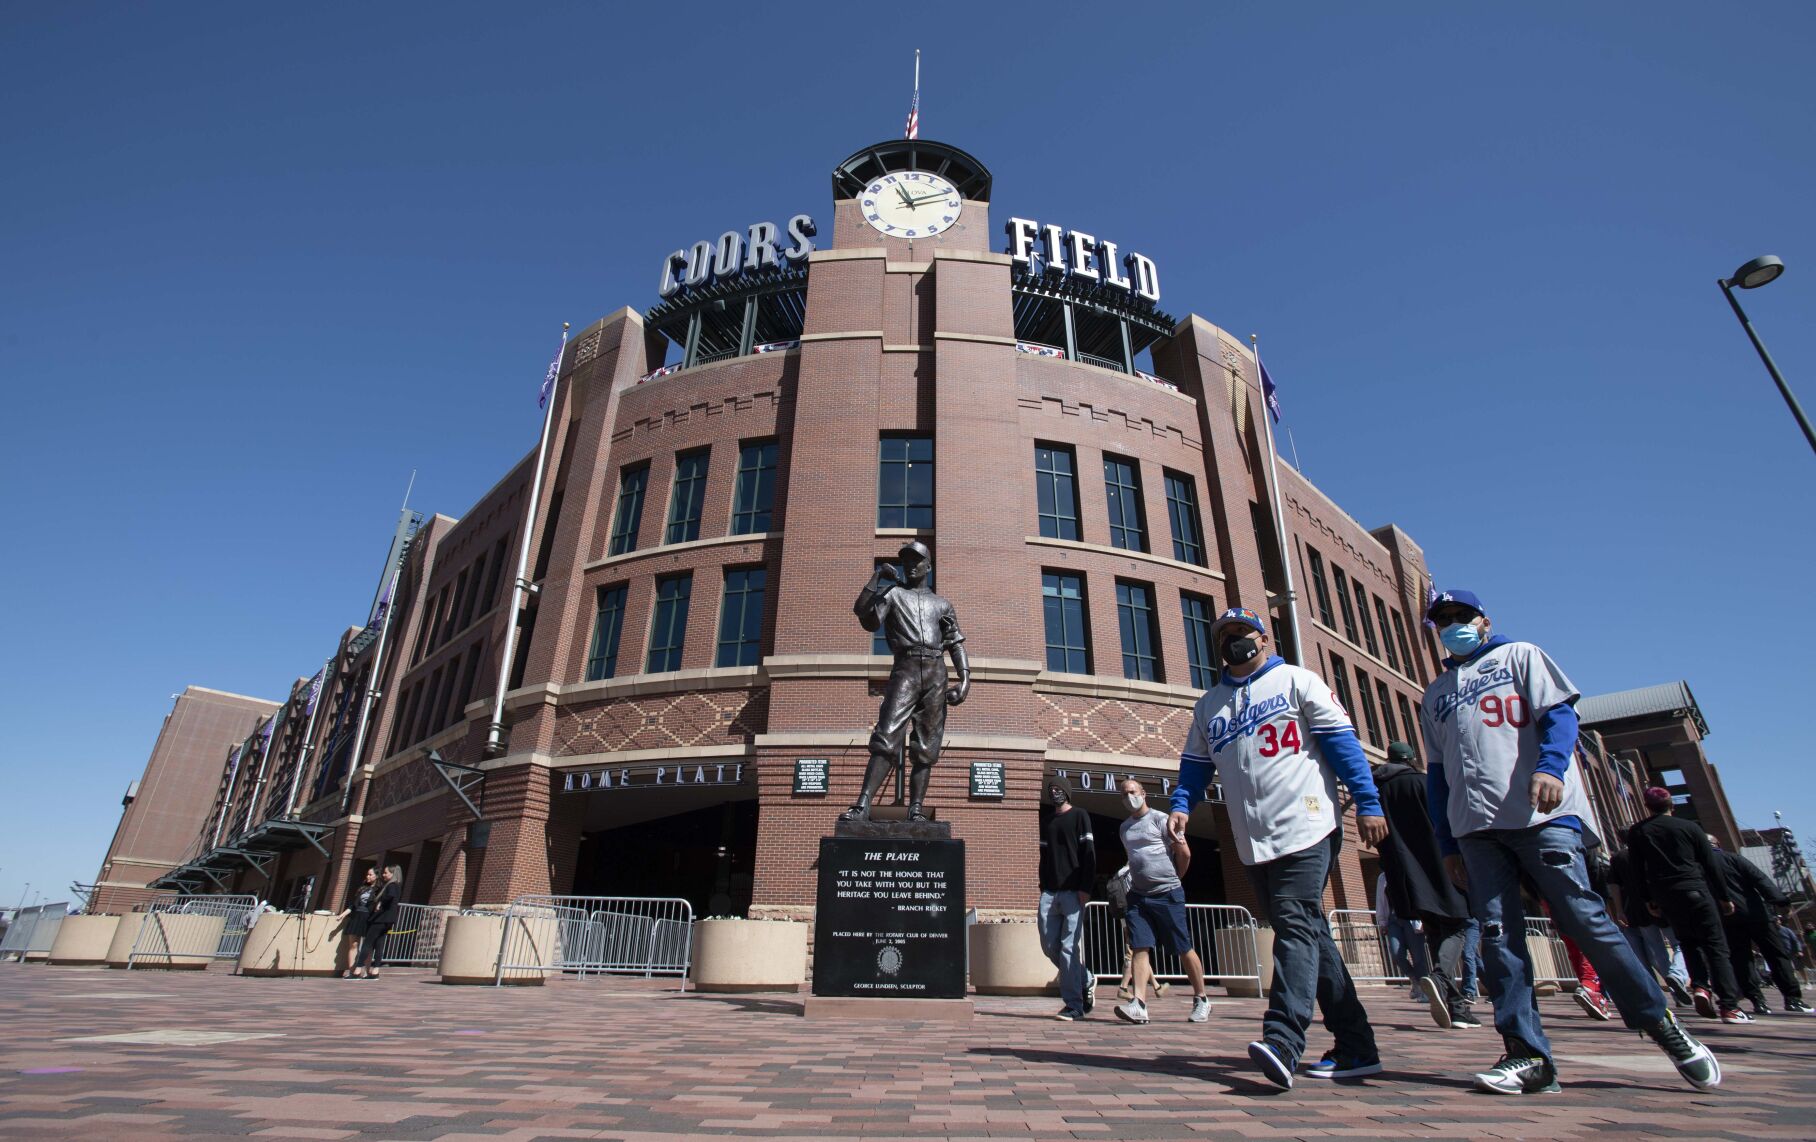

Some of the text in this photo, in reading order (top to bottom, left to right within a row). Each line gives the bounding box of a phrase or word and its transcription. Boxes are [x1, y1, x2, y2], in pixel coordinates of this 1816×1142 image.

[883, 175, 897, 184] 11
[904, 173, 920, 181] 12
[868, 184, 882, 194] 10
[864, 199, 875, 207] 9
[868, 213, 880, 222] 8
[943, 215, 954, 223] 4
[905, 229, 916, 237] 6
[927, 225, 938, 233] 5
[659, 214, 817, 297] COORS
[1006, 217, 1161, 303] FIELD
[1434, 667, 1515, 723] Dodgers
[1479, 694, 1530, 728] 90
[1207, 693, 1290, 754] Dodgers
[1257, 720, 1301, 757] 34
[564, 763, 744, 791] HOME PLATE
[864, 852, 920, 861] THE PLAYER
[898, 881, 913, 889] YOU
[916, 881, 930, 889] BUT
[873, 891, 889, 899] YOU
[891, 891, 912, 899] LEAVE
